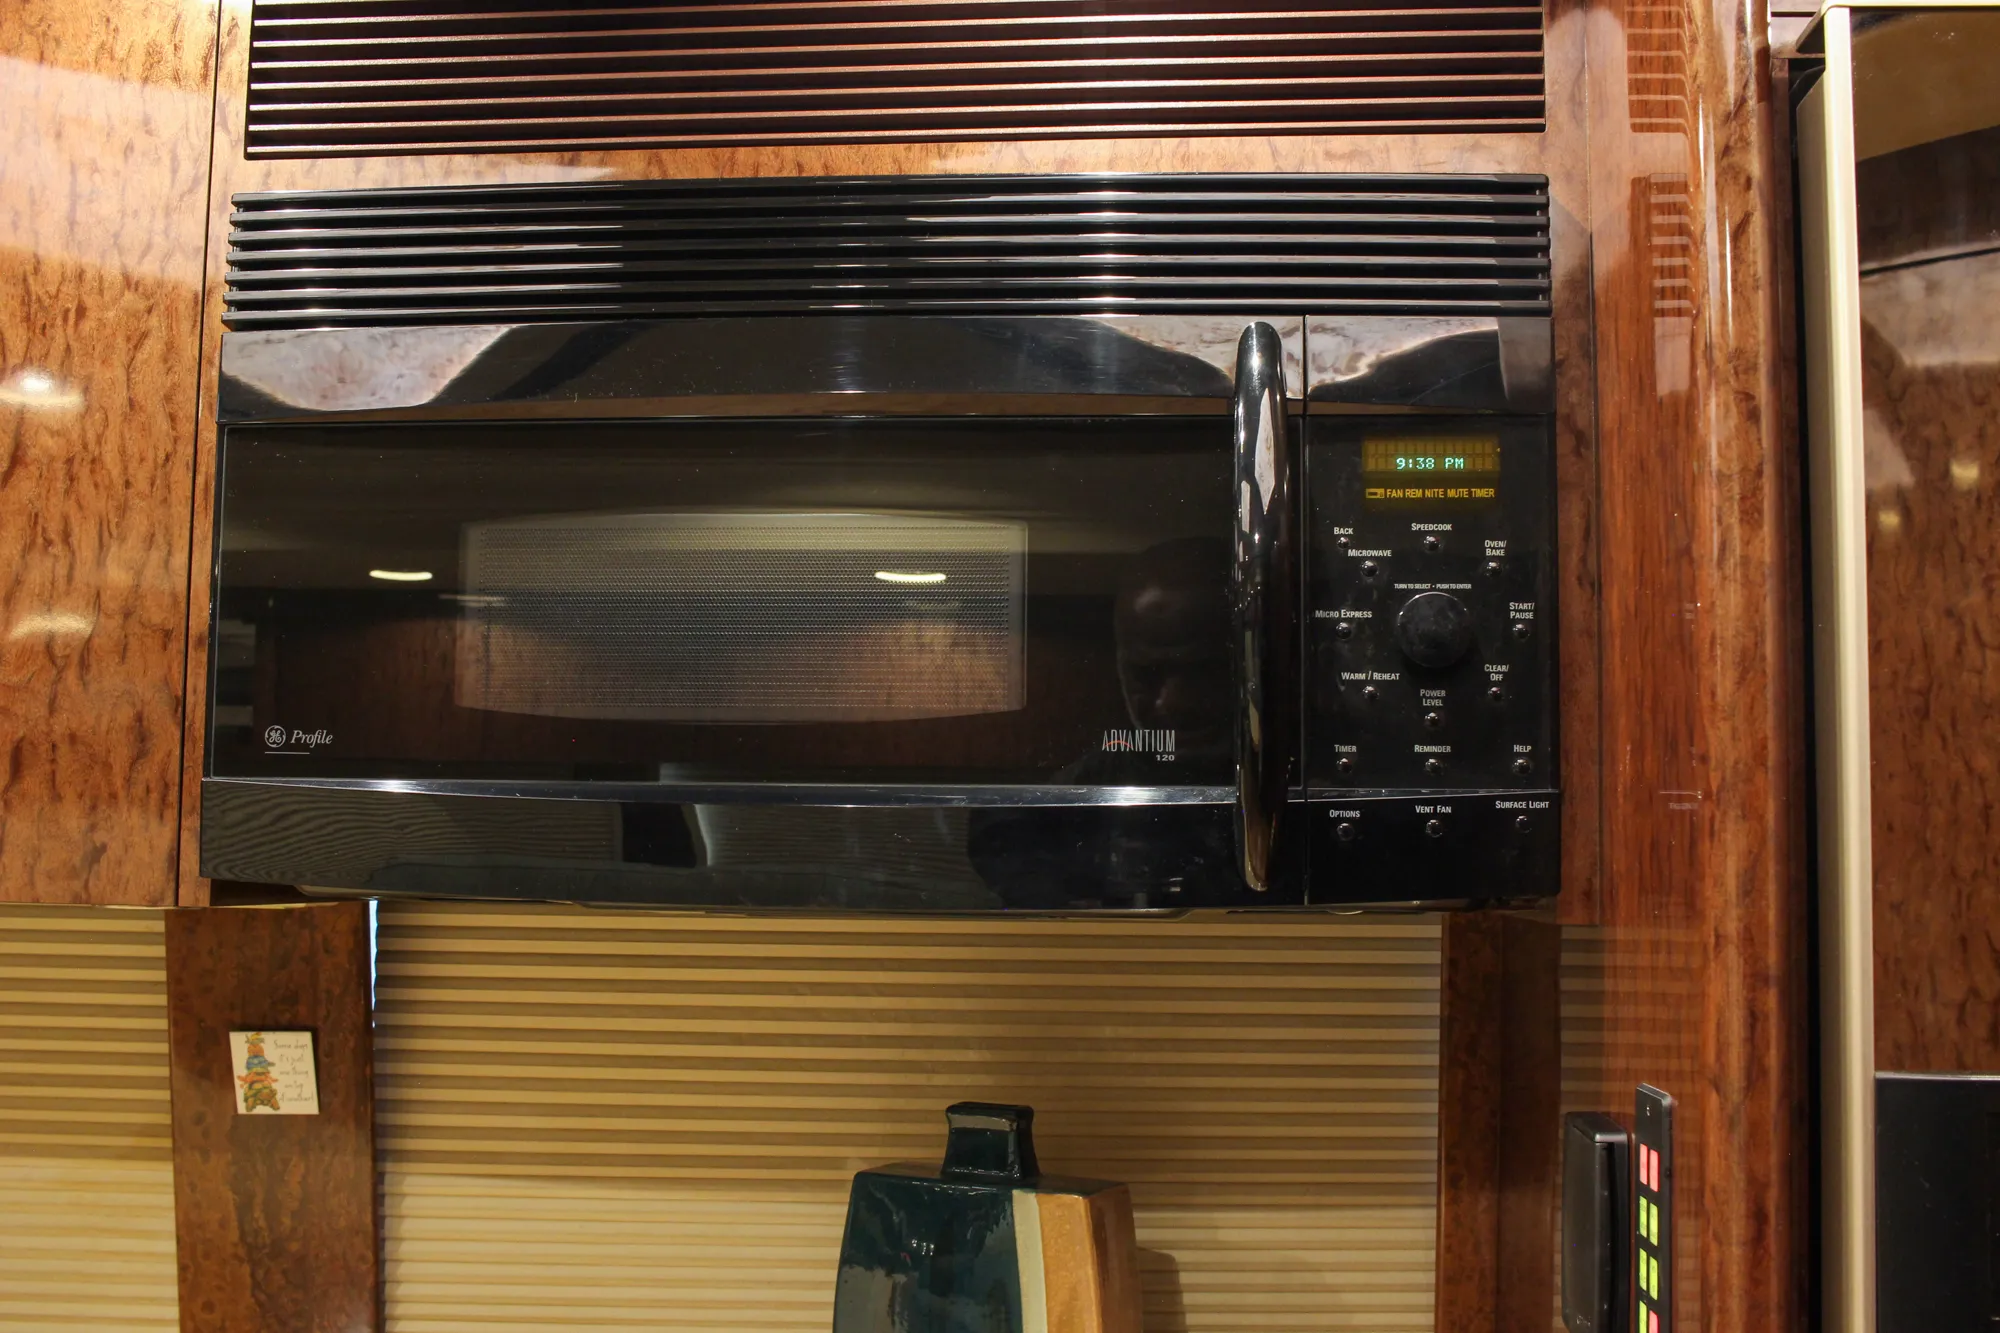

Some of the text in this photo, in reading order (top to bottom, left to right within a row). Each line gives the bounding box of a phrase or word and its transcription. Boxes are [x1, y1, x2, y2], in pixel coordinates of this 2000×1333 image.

[1396, 457, 1464, 470] 9:38 PM
[1386, 488, 1495, 498] FAN REM NITE MUTE TIMER
[1333, 526, 1354, 535] BACK
[1411, 522, 1452, 531] SPEEDCOOK
[1484, 539, 1507, 548] OVEN/
[1348, 549, 1392, 557] MICROWAVE
[1485, 548, 1505, 556] BAKE
[1509, 602, 1535, 610] START/
[1315, 609, 1372, 618] MICRO EXPRESS
[1510, 611, 1534, 620] PAUSE
[1484, 664, 1509, 672] CLEAR/
[1341, 672, 1366, 680] WARM
[1373, 672, 1400, 681] REHEAT
[1490, 673, 1503, 681] OFF
[1420, 689, 1446, 697] POWER
[1422, 698, 1443, 706] LEVEL
[290, 729, 333, 748] Profile
[1102, 729, 1176, 752] ADVANTIUM
[1334, 745, 1357, 753] TIMER
[1414, 745, 1451, 753] REMINDER
[1513, 745, 1531, 753] HELP
[1156, 754, 1175, 762] 120
[1495, 801, 1549, 809] SURFACE LIGHT
[1329, 809, 1360, 818] OPTIONS
[1415, 805, 1452, 814] VENT FAN
